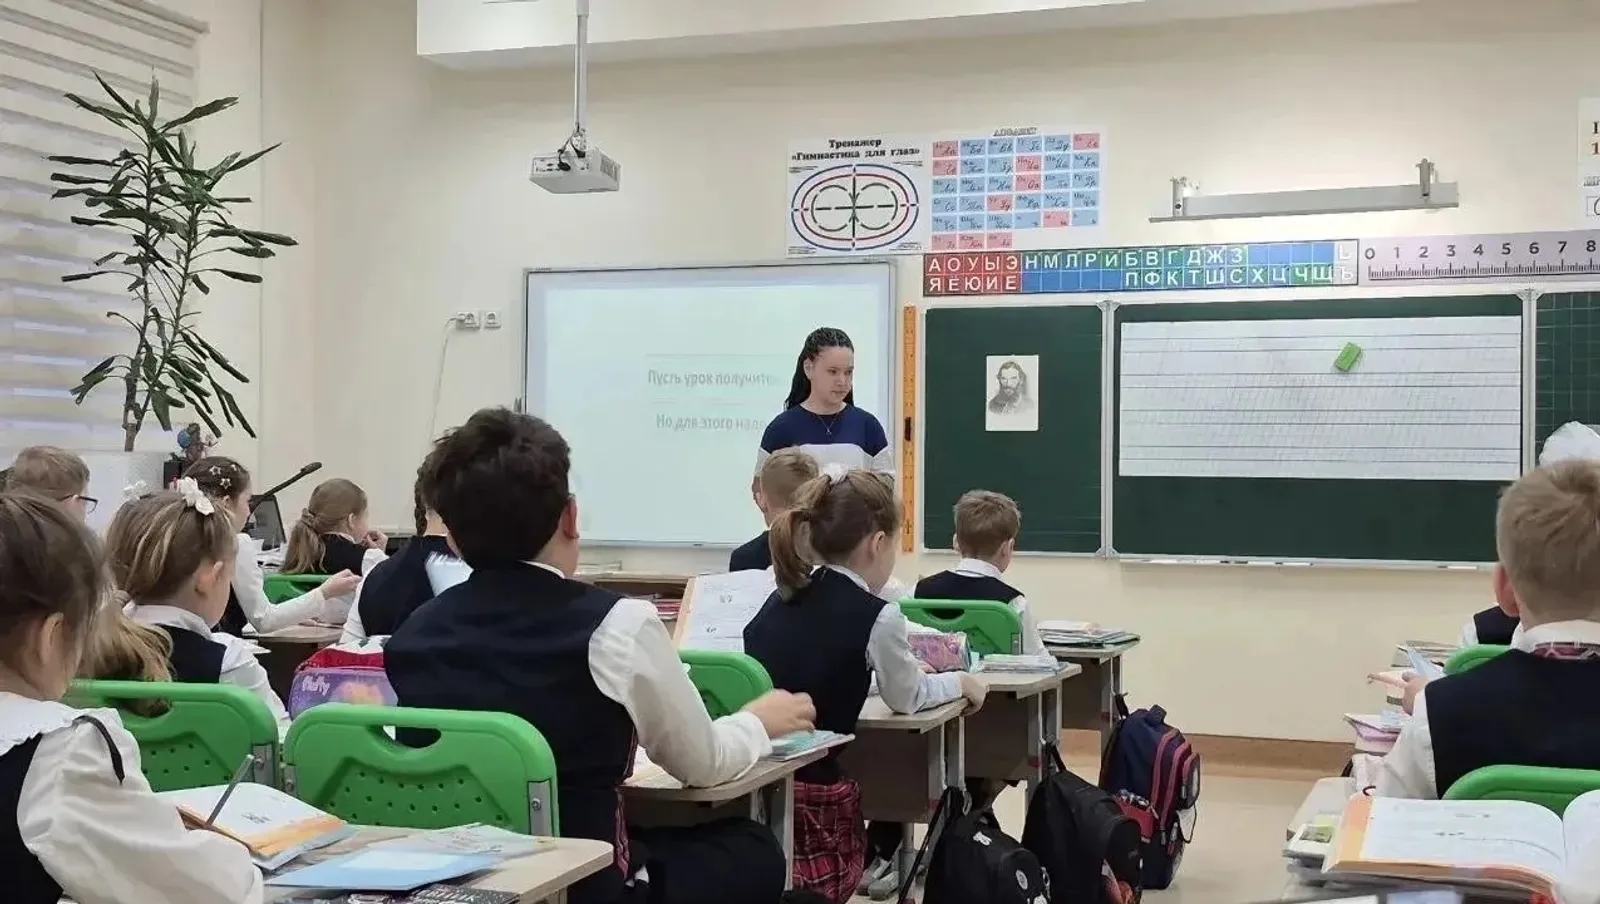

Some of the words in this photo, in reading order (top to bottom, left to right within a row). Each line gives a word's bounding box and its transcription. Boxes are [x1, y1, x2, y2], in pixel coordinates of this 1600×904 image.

[828, 139, 882, 149] Тренажер
[792, 151, 860, 161] «Гимнастика
[865, 148, 886, 158] для
[890, 148, 920, 156] глаз»
[1365, 248, 1375, 260] 0
[1419, 247, 1429, 258] 2
[1447, 245, 1456, 257] 3
[1473, 244, 1484, 255] 4
[1502, 243, 1511, 255] 5
[1530, 242, 1539, 254] 6
[1558, 241, 1567, 253] 7
[1586, 240, 1596, 252] 8
[929, 259, 941, 272] А
[948, 258, 960, 270] О
[969, 257, 980, 270] У
[985, 257, 1000, 270] Ы
[1006, 256, 1017, 269] Э
[1026, 256, 1037, 269] Н
[1044, 254, 1058, 268] М
[1066, 254, 1077, 268] Л
[1086, 254, 1096, 267] Р
[1126, 252, 1138, 266] Б
[1147, 252, 1158, 265] В
[1168, 251, 1178, 264] Г
[1188, 250, 1202, 266] Д
[1207, 249, 1224, 264] Ж
[1232, 248, 1242, 263] З
[929, 278, 940, 291] Я
[965, 277, 980, 290] Ю
[987, 277, 997, 290] И
[1005, 276, 1016, 289] Е
[1126, 272, 1138, 286] П
[1145, 272, 1160, 285] Ф
[1168, 271, 1178, 284] К
[1189, 270, 1202, 284] Т
[1206, 270, 1224, 284] Ш
[1230, 269, 1243, 283] С
[1252, 269, 1264, 282] Х
[1273, 268, 1286, 283] Ц
[1295, 267, 1308, 280] Ч
[1313, 266, 1333, 282] Щ
[1341, 266, 1353, 280] Ъ
[648, 369, 681, 387] Пусть
[684, 372, 713, 388] урок
[655, 413, 672, 428] Но
[673, 416, 698, 432] для
[701, 416, 733, 429] этого
